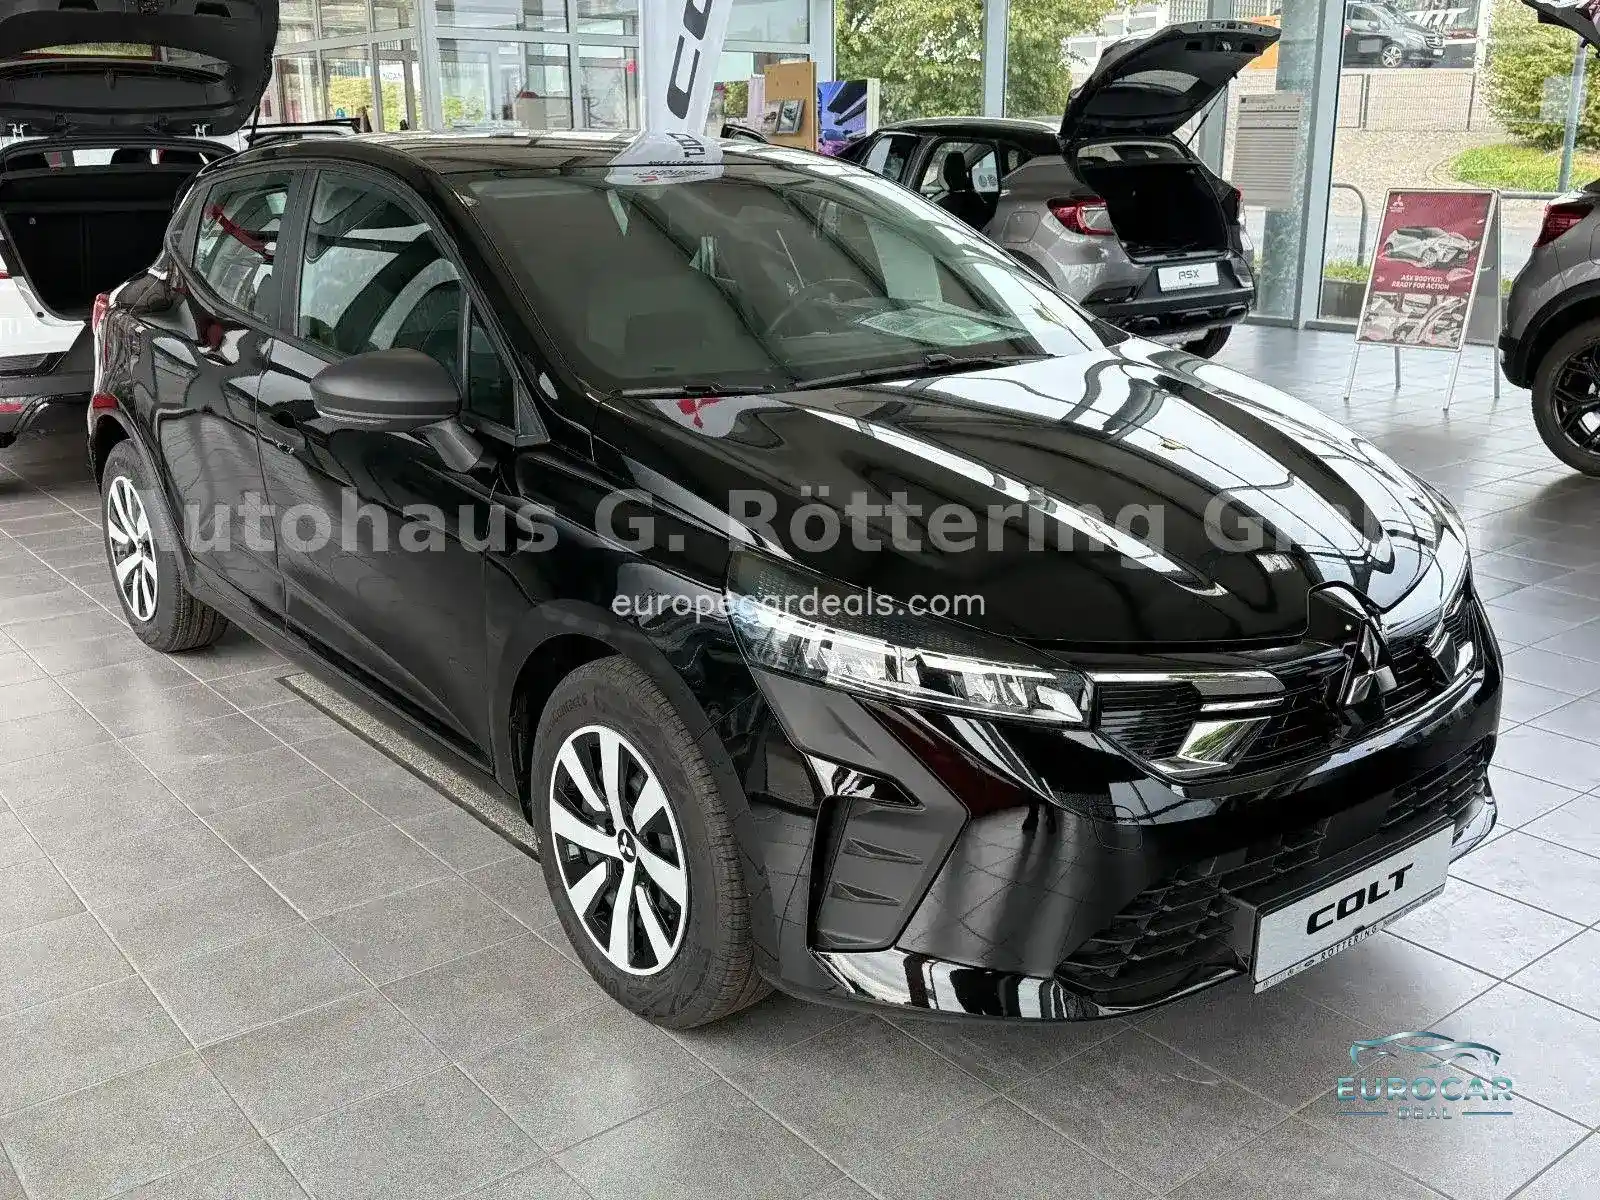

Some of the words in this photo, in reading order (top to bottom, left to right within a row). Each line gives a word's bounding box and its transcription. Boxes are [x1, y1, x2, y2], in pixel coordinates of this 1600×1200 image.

[1391, 280, 1413, 288] READY
[1426, 282, 1450, 290] ACTION
[1306, 862, 1415, 936] COLT
